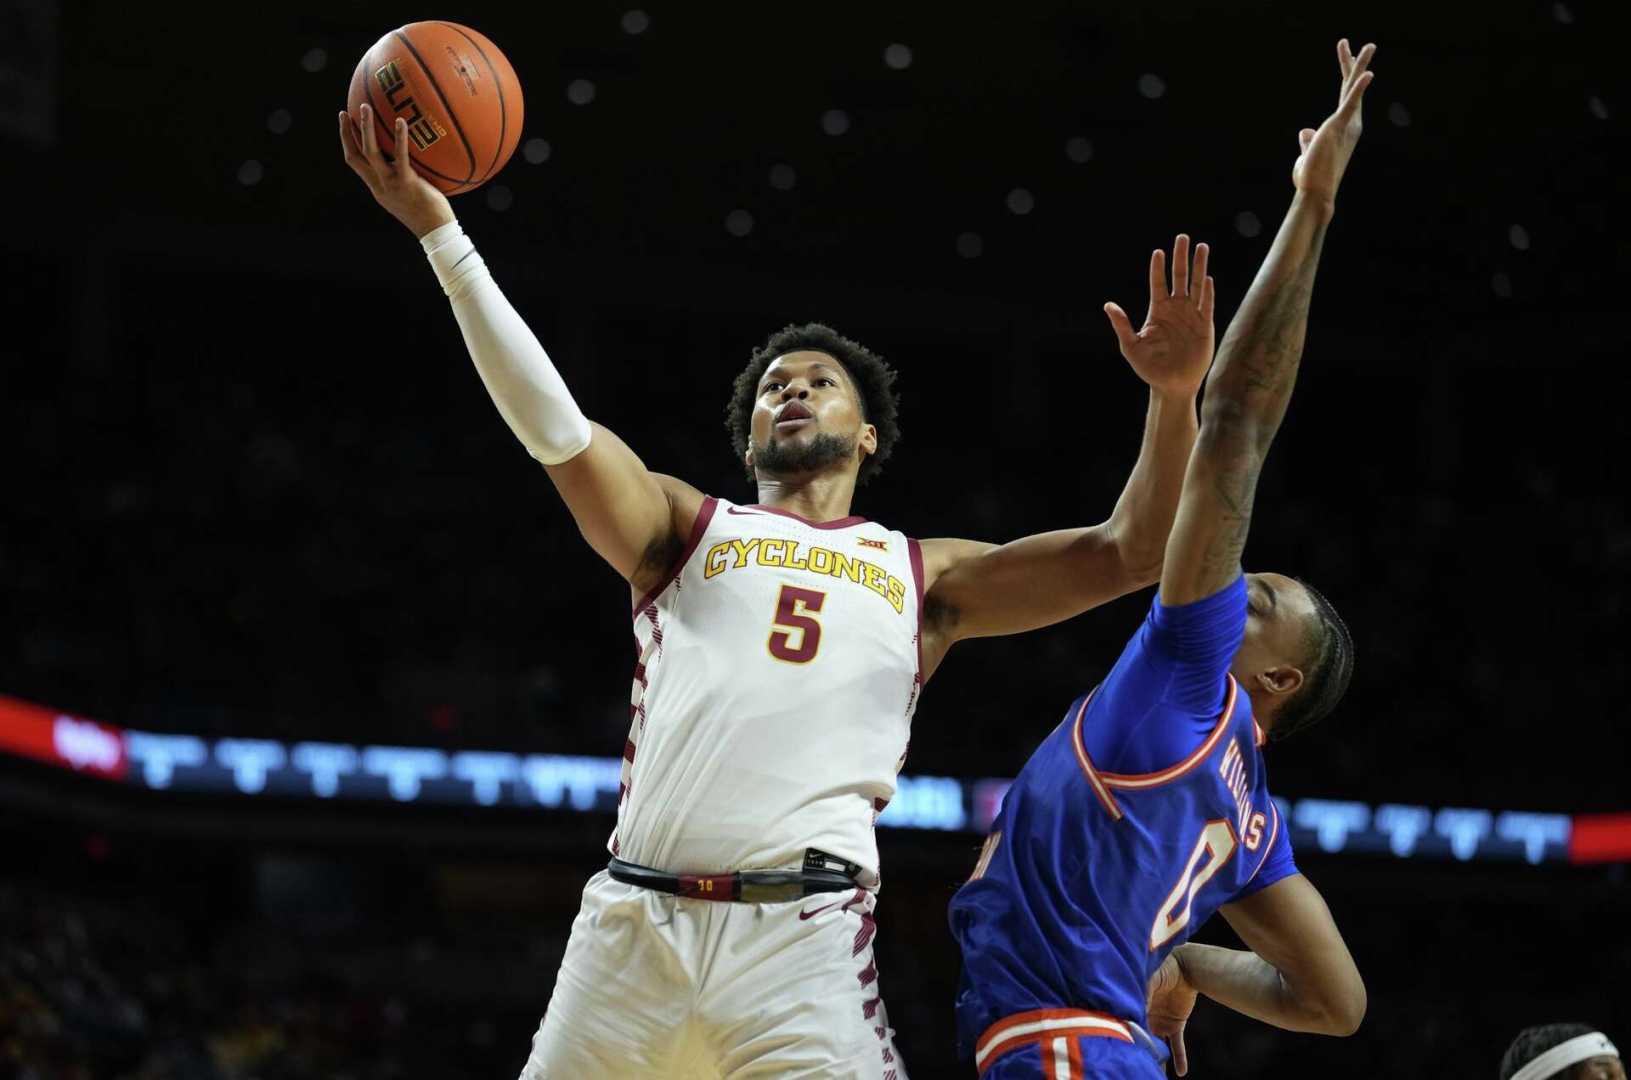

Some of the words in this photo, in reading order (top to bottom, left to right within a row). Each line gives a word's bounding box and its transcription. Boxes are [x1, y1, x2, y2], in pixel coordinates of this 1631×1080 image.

[704, 538, 906, 615] CYCLONES
[767, 581, 828, 666] 5
[1149, 818, 1239, 952] 0
